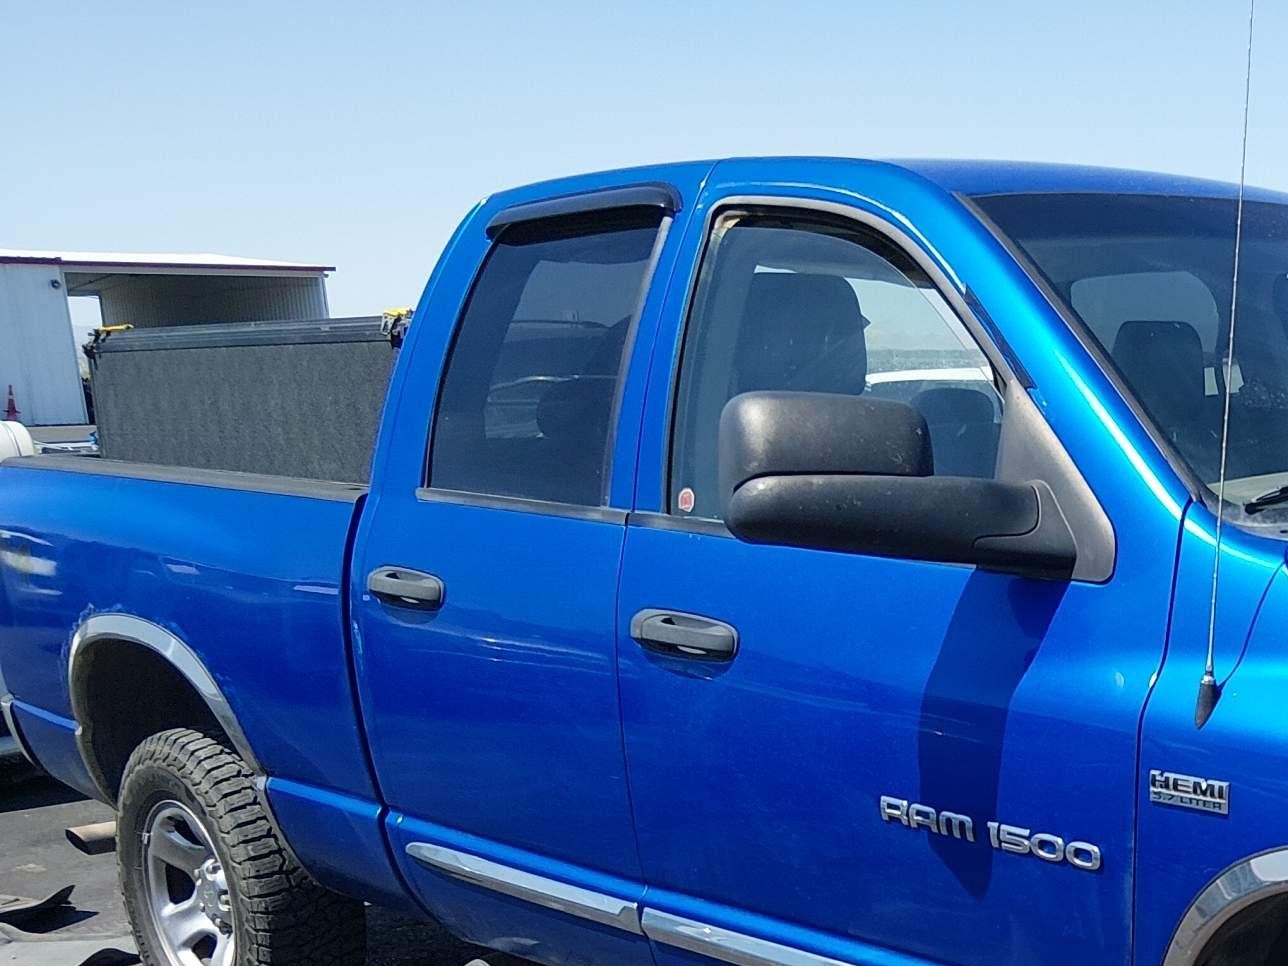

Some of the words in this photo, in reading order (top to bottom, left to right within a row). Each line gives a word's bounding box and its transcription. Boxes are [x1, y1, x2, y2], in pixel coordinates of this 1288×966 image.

[1150, 771, 1228, 801] HEMI
[1180, 795, 1223, 811] LITER
[880, 795, 975, 843] RAM
[987, 821, 1101, 871] 1500
